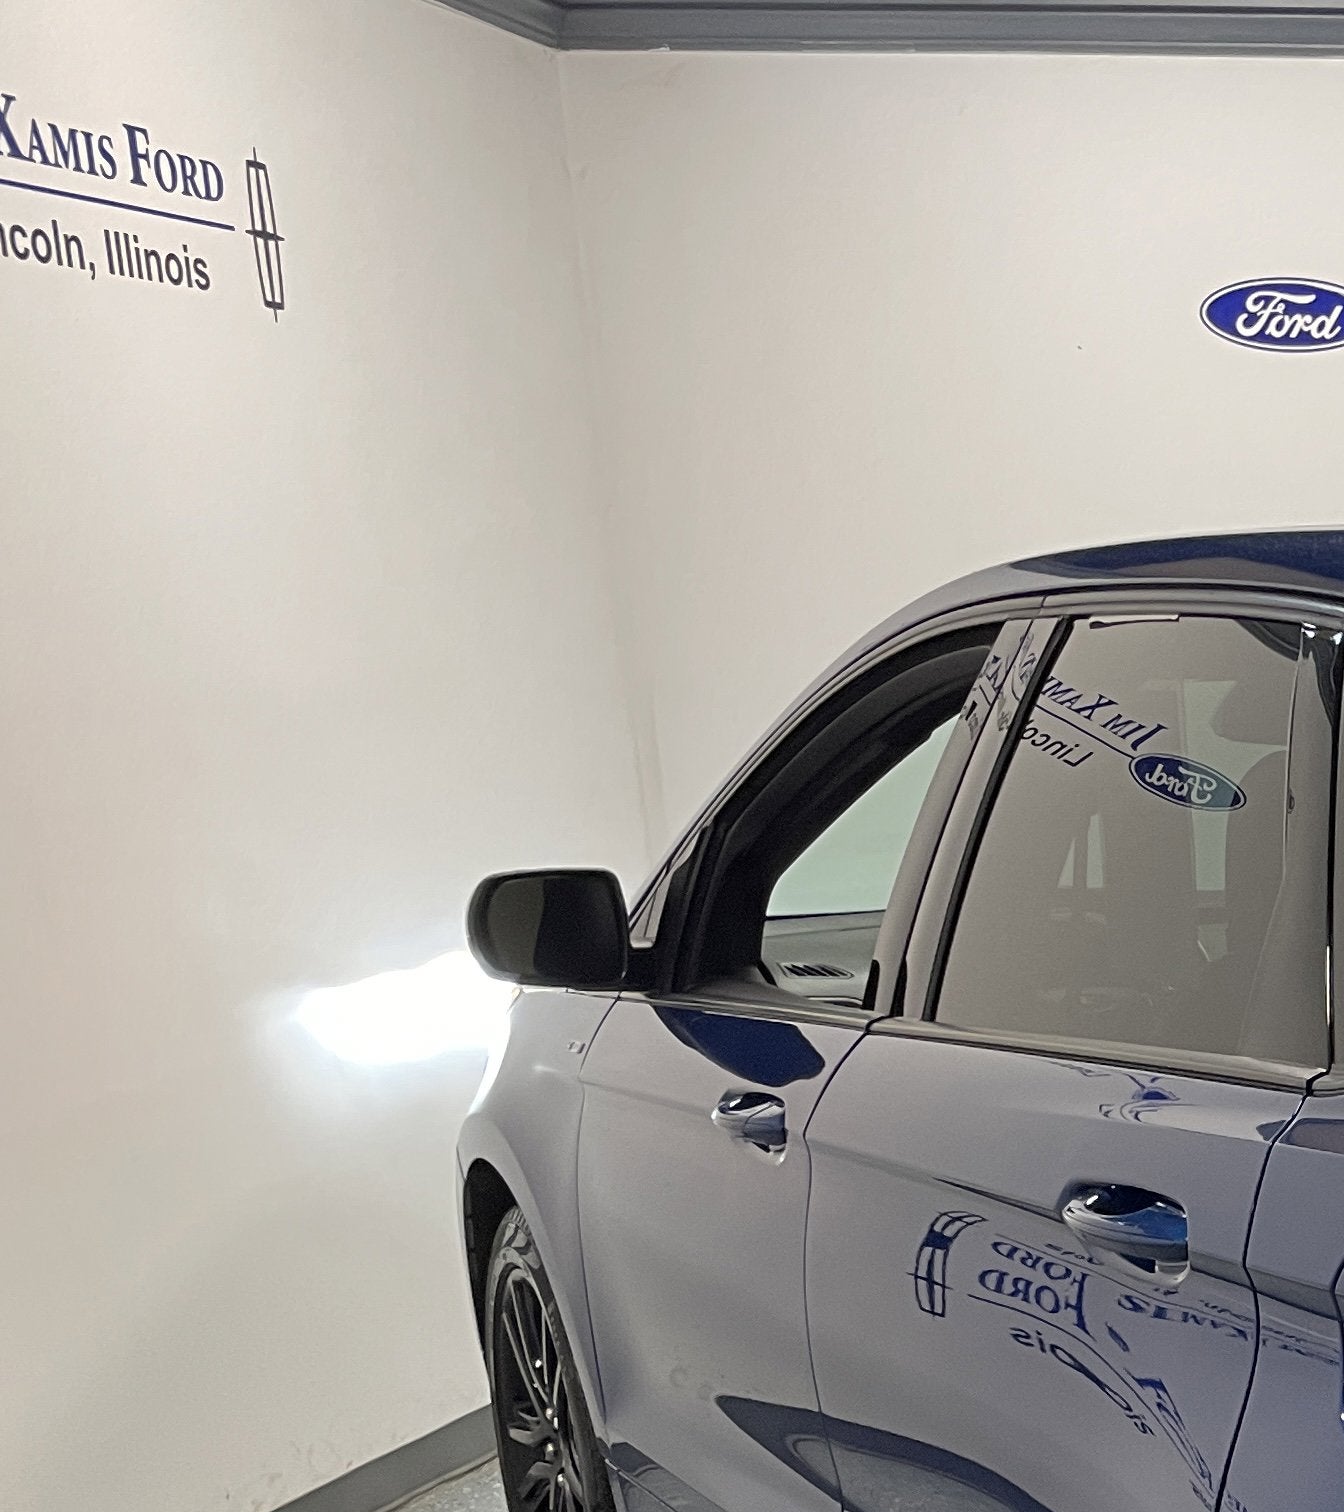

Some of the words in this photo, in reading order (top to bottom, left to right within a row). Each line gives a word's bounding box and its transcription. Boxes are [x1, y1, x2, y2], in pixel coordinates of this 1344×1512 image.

[122, 123, 224, 202] FORD
[0, 219, 96, 281] coln,
[103, 228, 211, 291] Illinois
[1235, 287, 1342, 341] Ford
